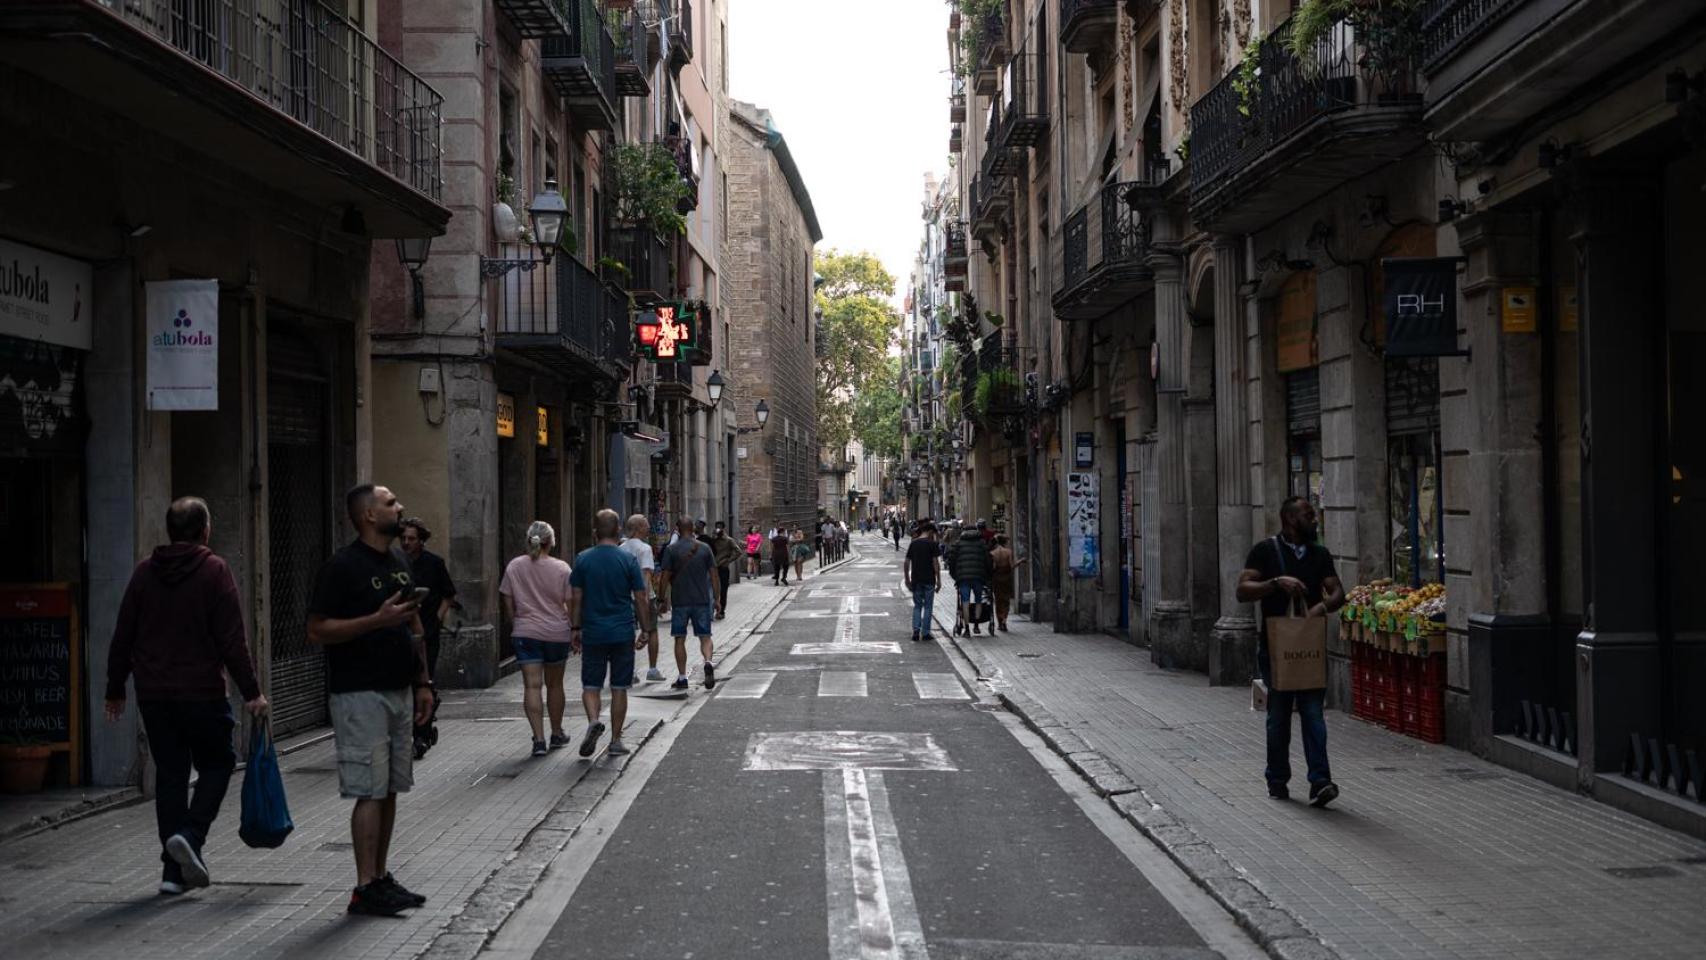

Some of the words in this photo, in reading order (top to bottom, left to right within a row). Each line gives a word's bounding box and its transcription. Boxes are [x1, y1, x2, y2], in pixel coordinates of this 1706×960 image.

[1397, 293, 1444, 314] RH
[153, 330, 213, 347] atubola
[35, 686, 66, 704] BEER
